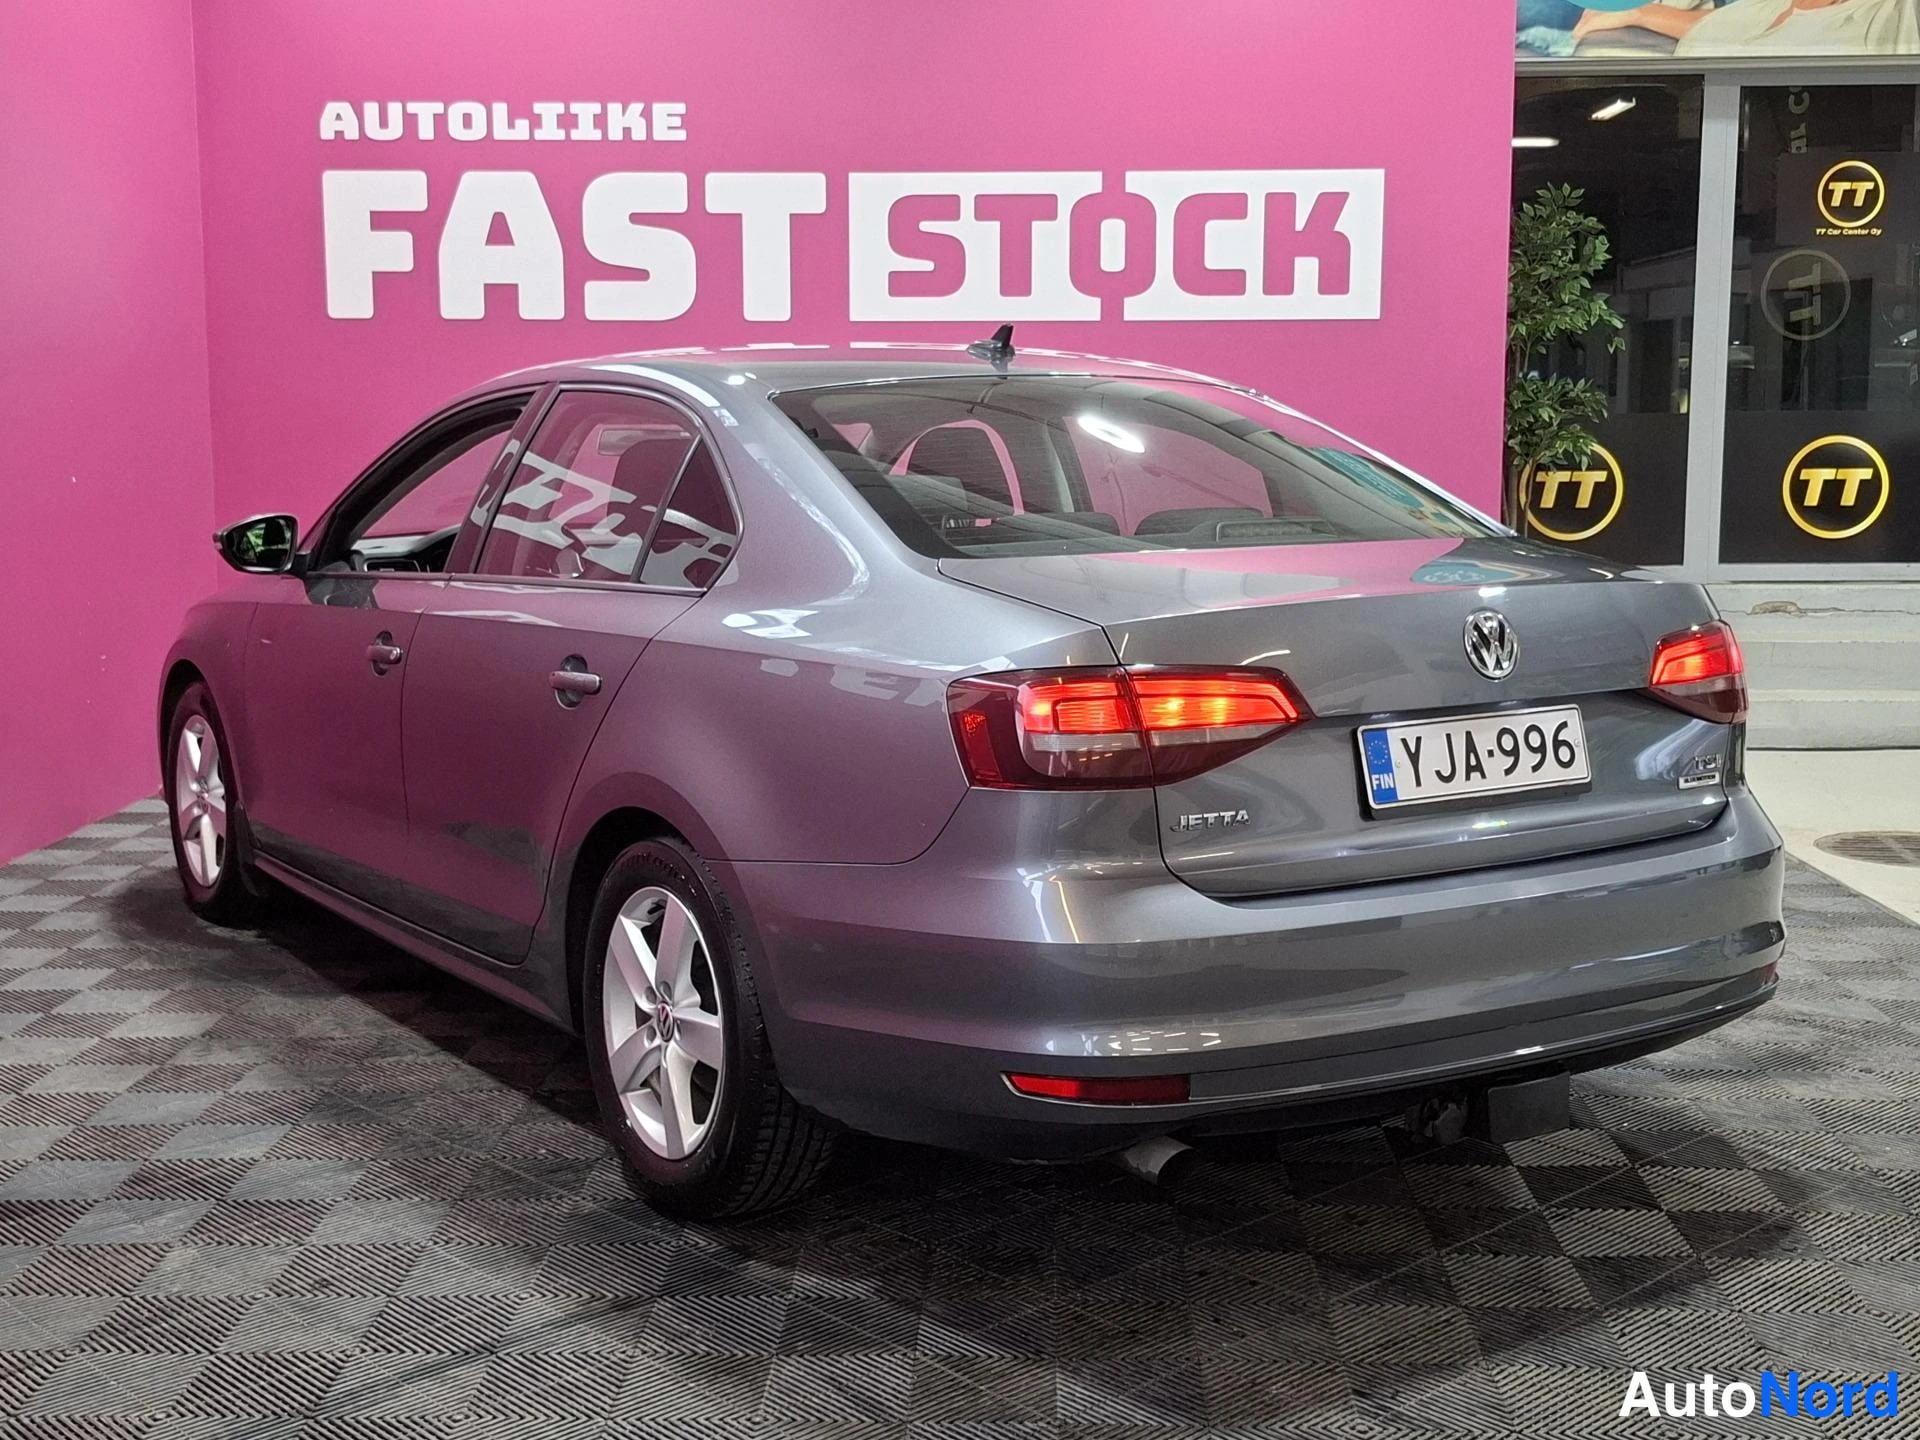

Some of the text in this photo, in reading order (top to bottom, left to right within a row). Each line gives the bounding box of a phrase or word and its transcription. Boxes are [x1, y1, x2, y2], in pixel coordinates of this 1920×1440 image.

[319, 102, 688, 141] AUTOLIIKE
[1828, 181, 1875, 207] TT
[322, 169, 1352, 322] FAST STOCK
[1827, 228, 1841, 236] Car
[1842, 228, 1869, 236] Center
[1535, 470, 1608, 509] TT
[1800, 467, 1873, 507] TT
[1400, 720, 1576, 788] YJA-996
[1371, 772, 1395, 791] FIN
[1169, 809, 1251, 832] JETTA
